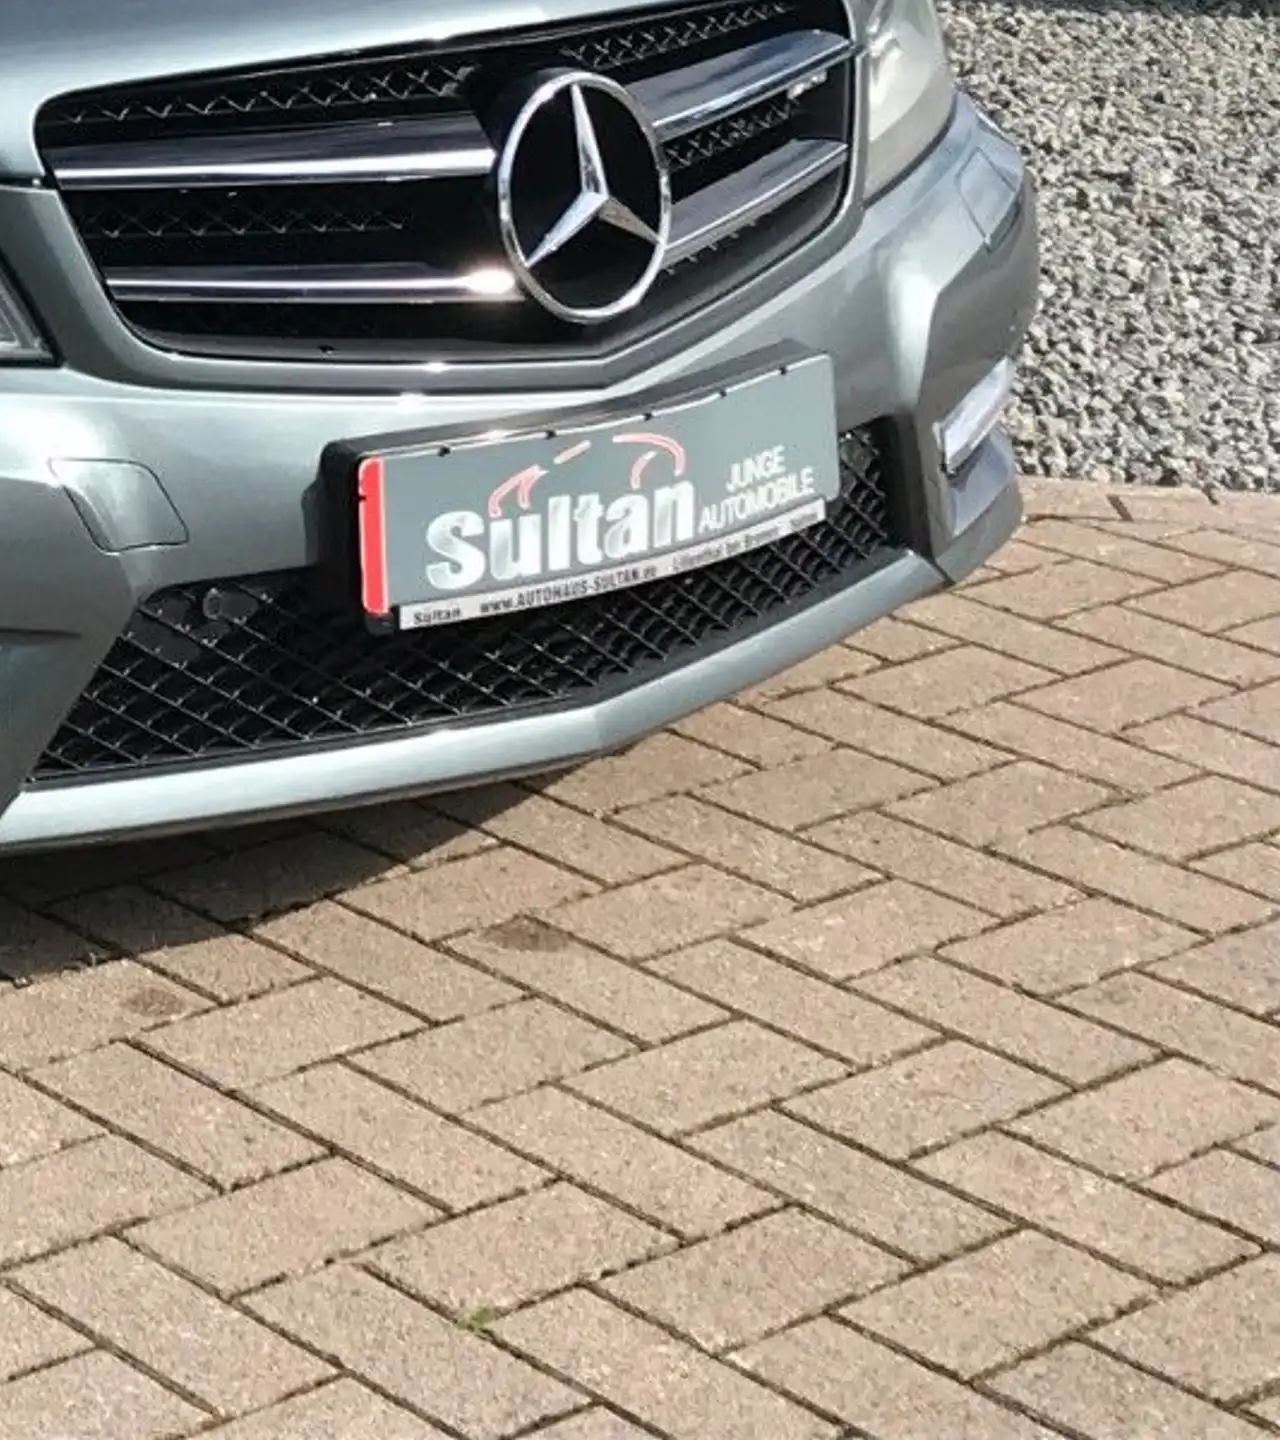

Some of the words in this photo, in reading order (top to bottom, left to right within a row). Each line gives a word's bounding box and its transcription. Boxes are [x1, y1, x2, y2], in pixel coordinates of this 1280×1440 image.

[698, 466, 816, 534] AUTOMOBILE
[726, 444, 786, 493] JUNGE
[425, 480, 694, 590] Sultan
